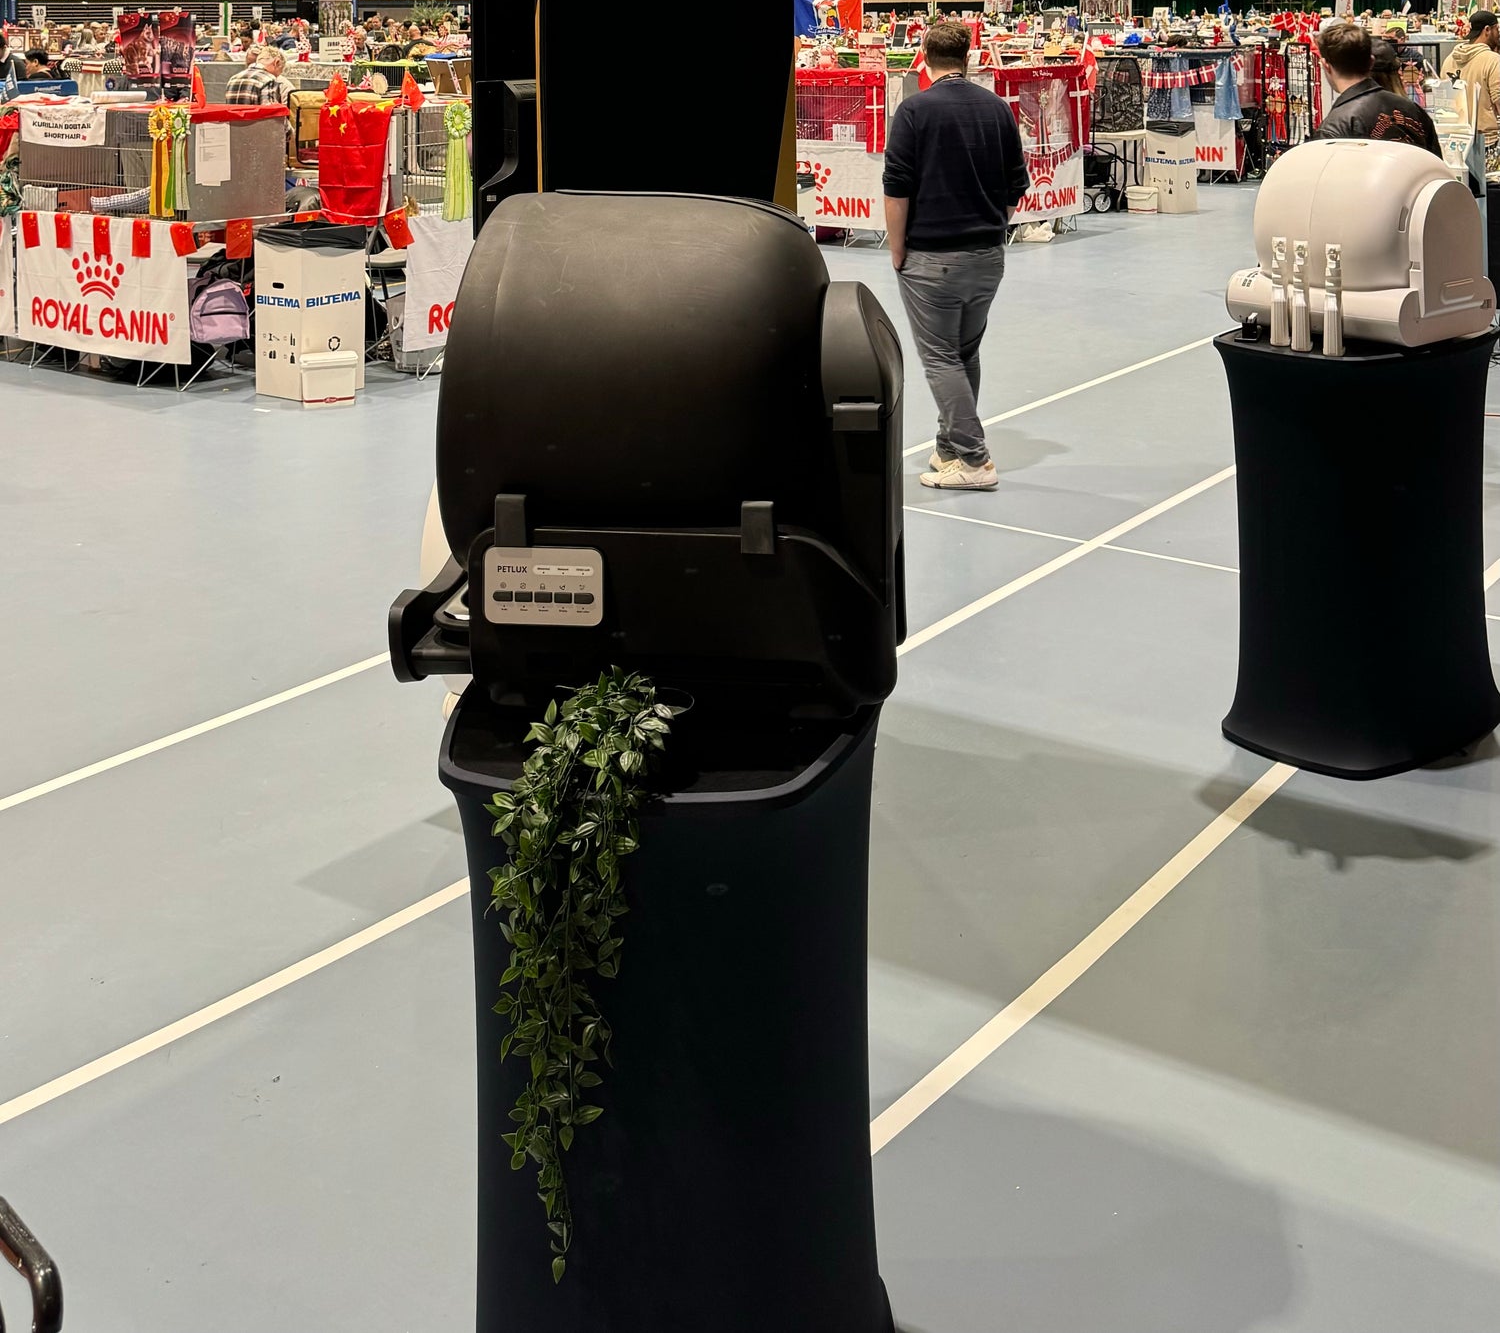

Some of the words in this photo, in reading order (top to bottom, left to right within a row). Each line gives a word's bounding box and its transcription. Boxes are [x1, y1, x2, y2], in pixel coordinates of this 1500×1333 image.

[35, 8, 44, 16] 10
[32, 120, 63, 130] KURILIAN
[43, 131, 81, 140] SHORTHAIR
[1144, 156, 1177, 165] BILTEMA
[1044, 186, 1076, 209] CANIN
[256, 295, 300, 309] BILTEMA
[306, 290, 361, 308] BILTEMA
[32, 296, 93, 335] ROYAL
[99, 307, 168, 345] CANIN
[497, 565, 527, 573] PETLUX
